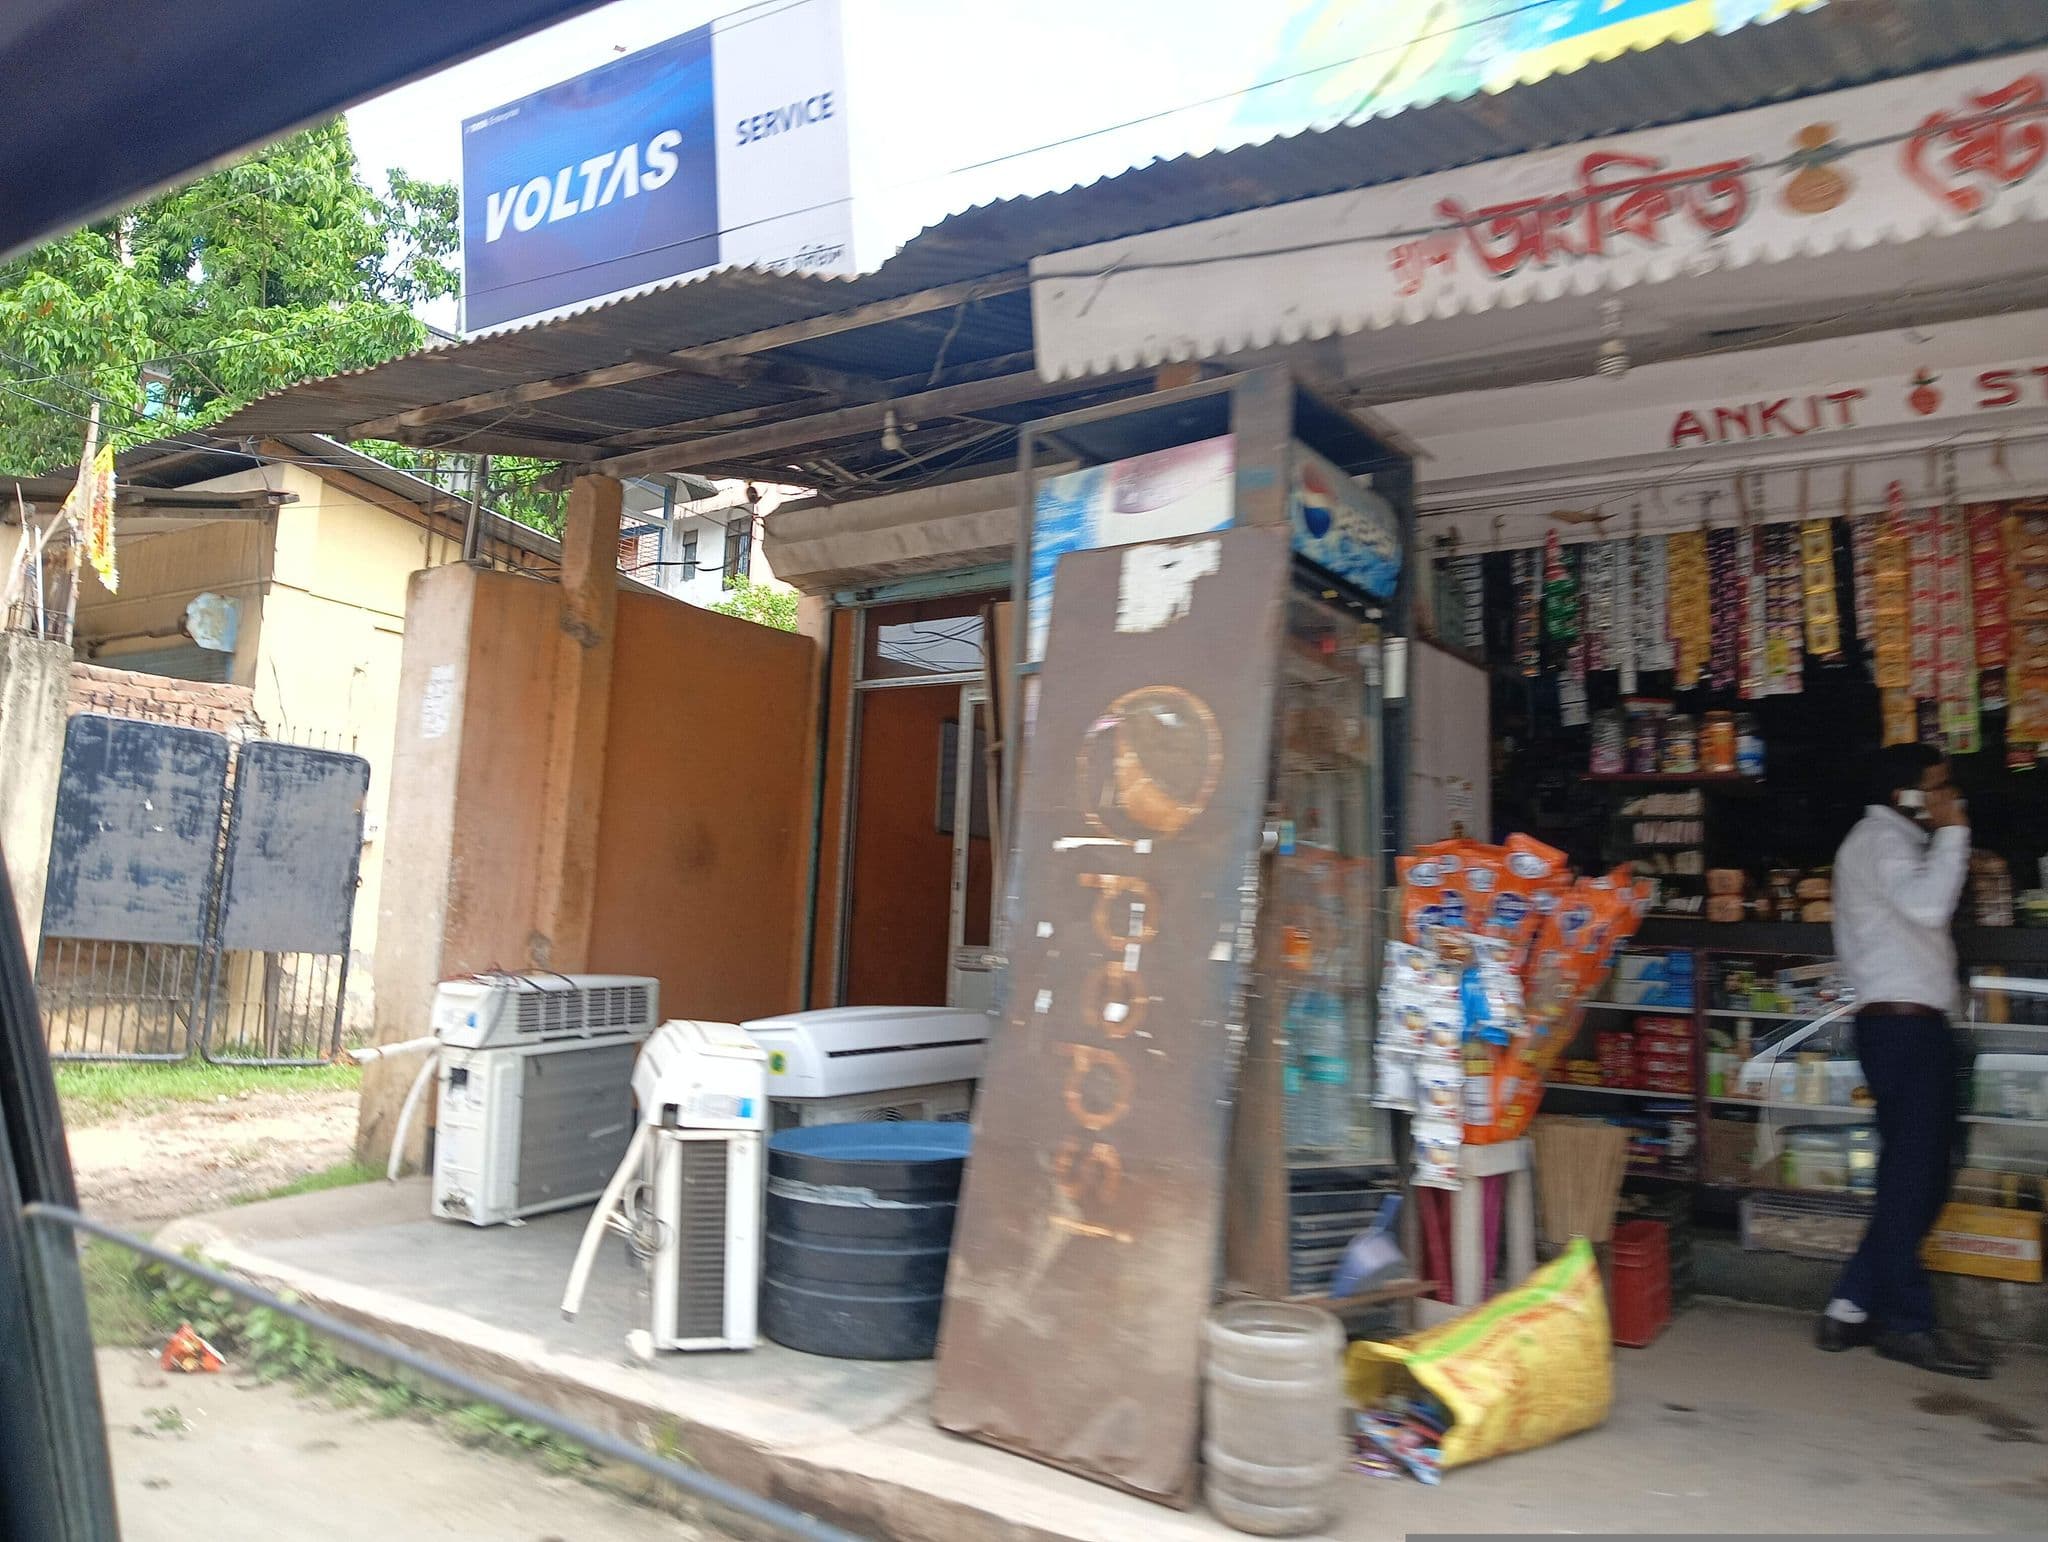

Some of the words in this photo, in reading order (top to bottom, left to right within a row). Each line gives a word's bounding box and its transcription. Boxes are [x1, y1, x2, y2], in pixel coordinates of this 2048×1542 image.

[735, 91, 835, 147] SERVICE
[485, 129, 683, 243] VOLTAS
[1669, 387, 1867, 448] ANKIT
